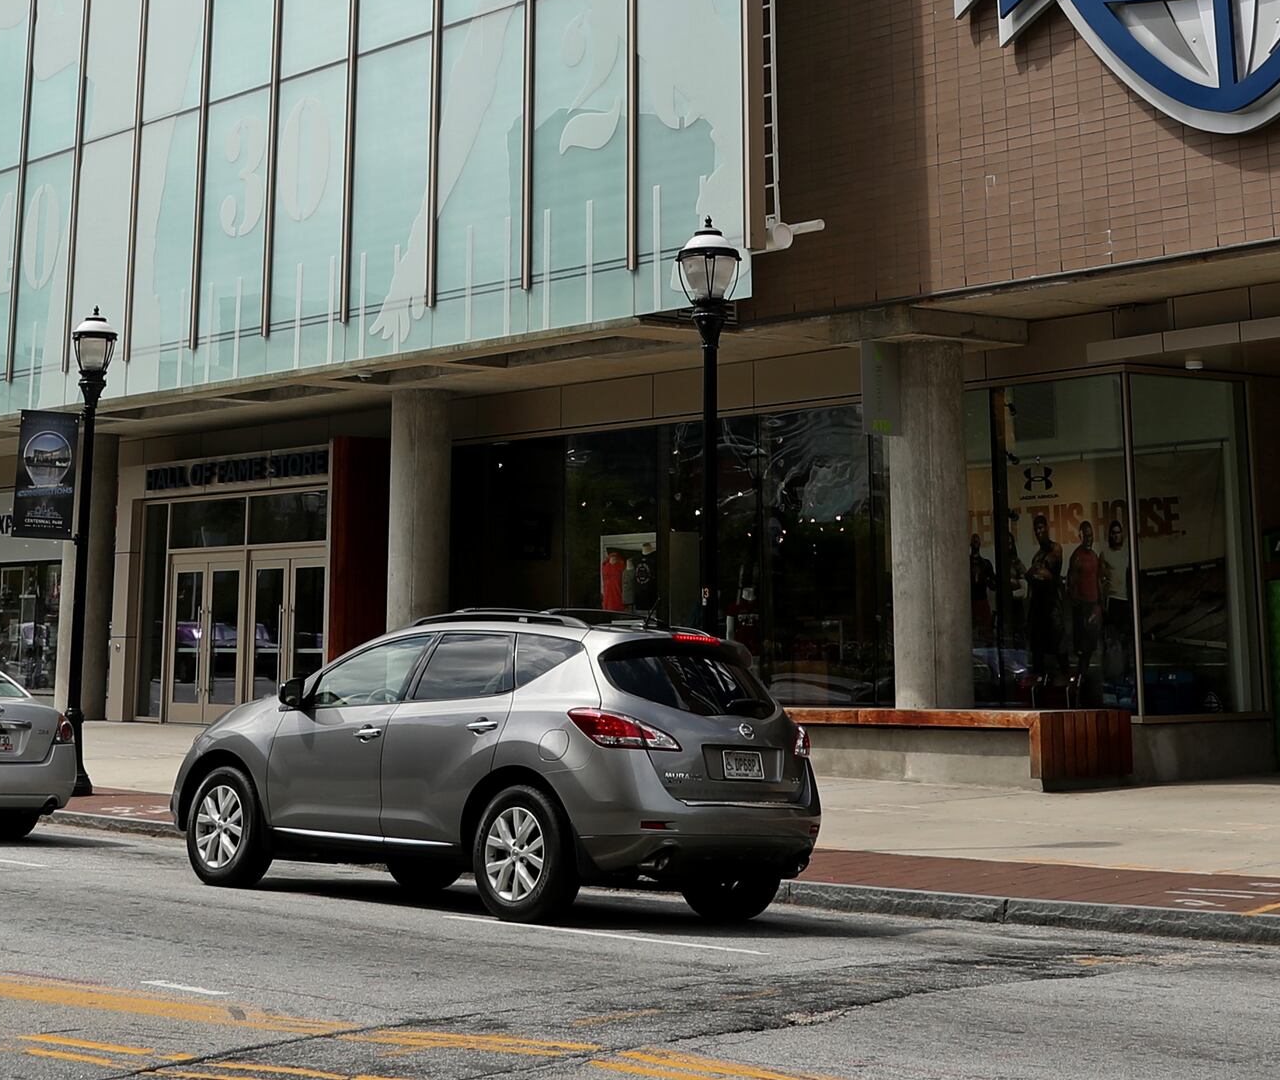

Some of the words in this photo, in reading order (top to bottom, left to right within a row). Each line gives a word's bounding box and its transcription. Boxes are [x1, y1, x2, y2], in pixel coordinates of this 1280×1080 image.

[221, 95, 331, 238] 30
[147, 465, 189, 491] HALL
[190, 462, 213, 487] OF
[217, 456, 267, 484] FAME
[268, 450, 329, 479] STORE
[1027, 502, 1084, 545] THIS
